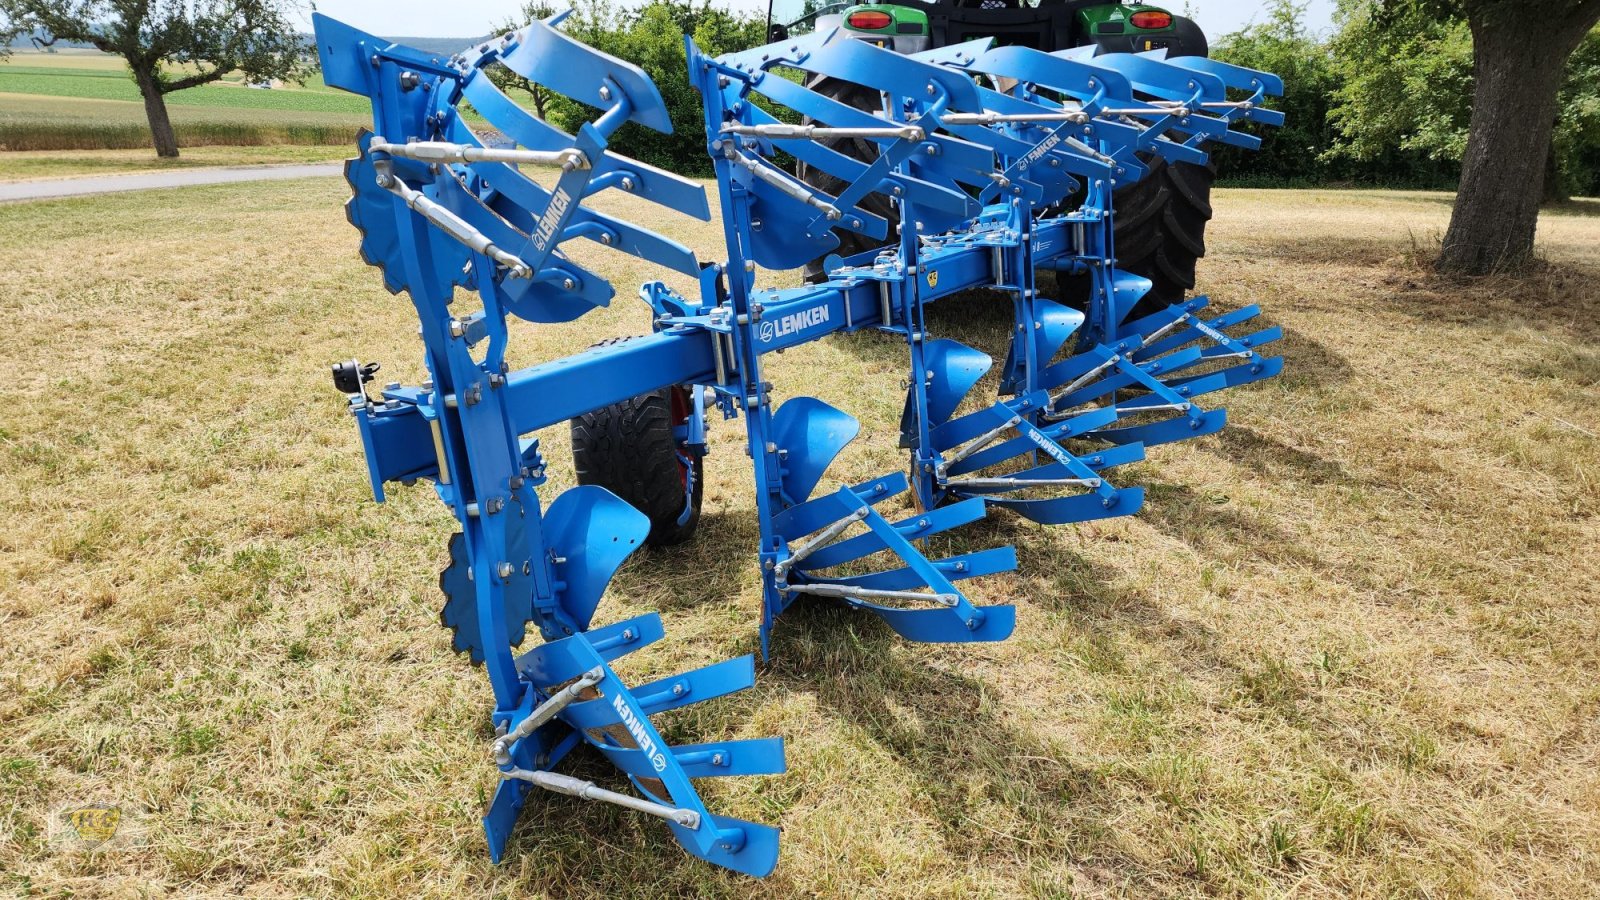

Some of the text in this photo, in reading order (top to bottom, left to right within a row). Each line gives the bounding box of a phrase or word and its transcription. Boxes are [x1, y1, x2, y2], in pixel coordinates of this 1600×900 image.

[537, 186, 571, 242] LEMKEN
[773, 304, 830, 338] LEMKEN
[1028, 429, 1063, 459] LEMKEN
[613, 694, 657, 759] LEMKEN
